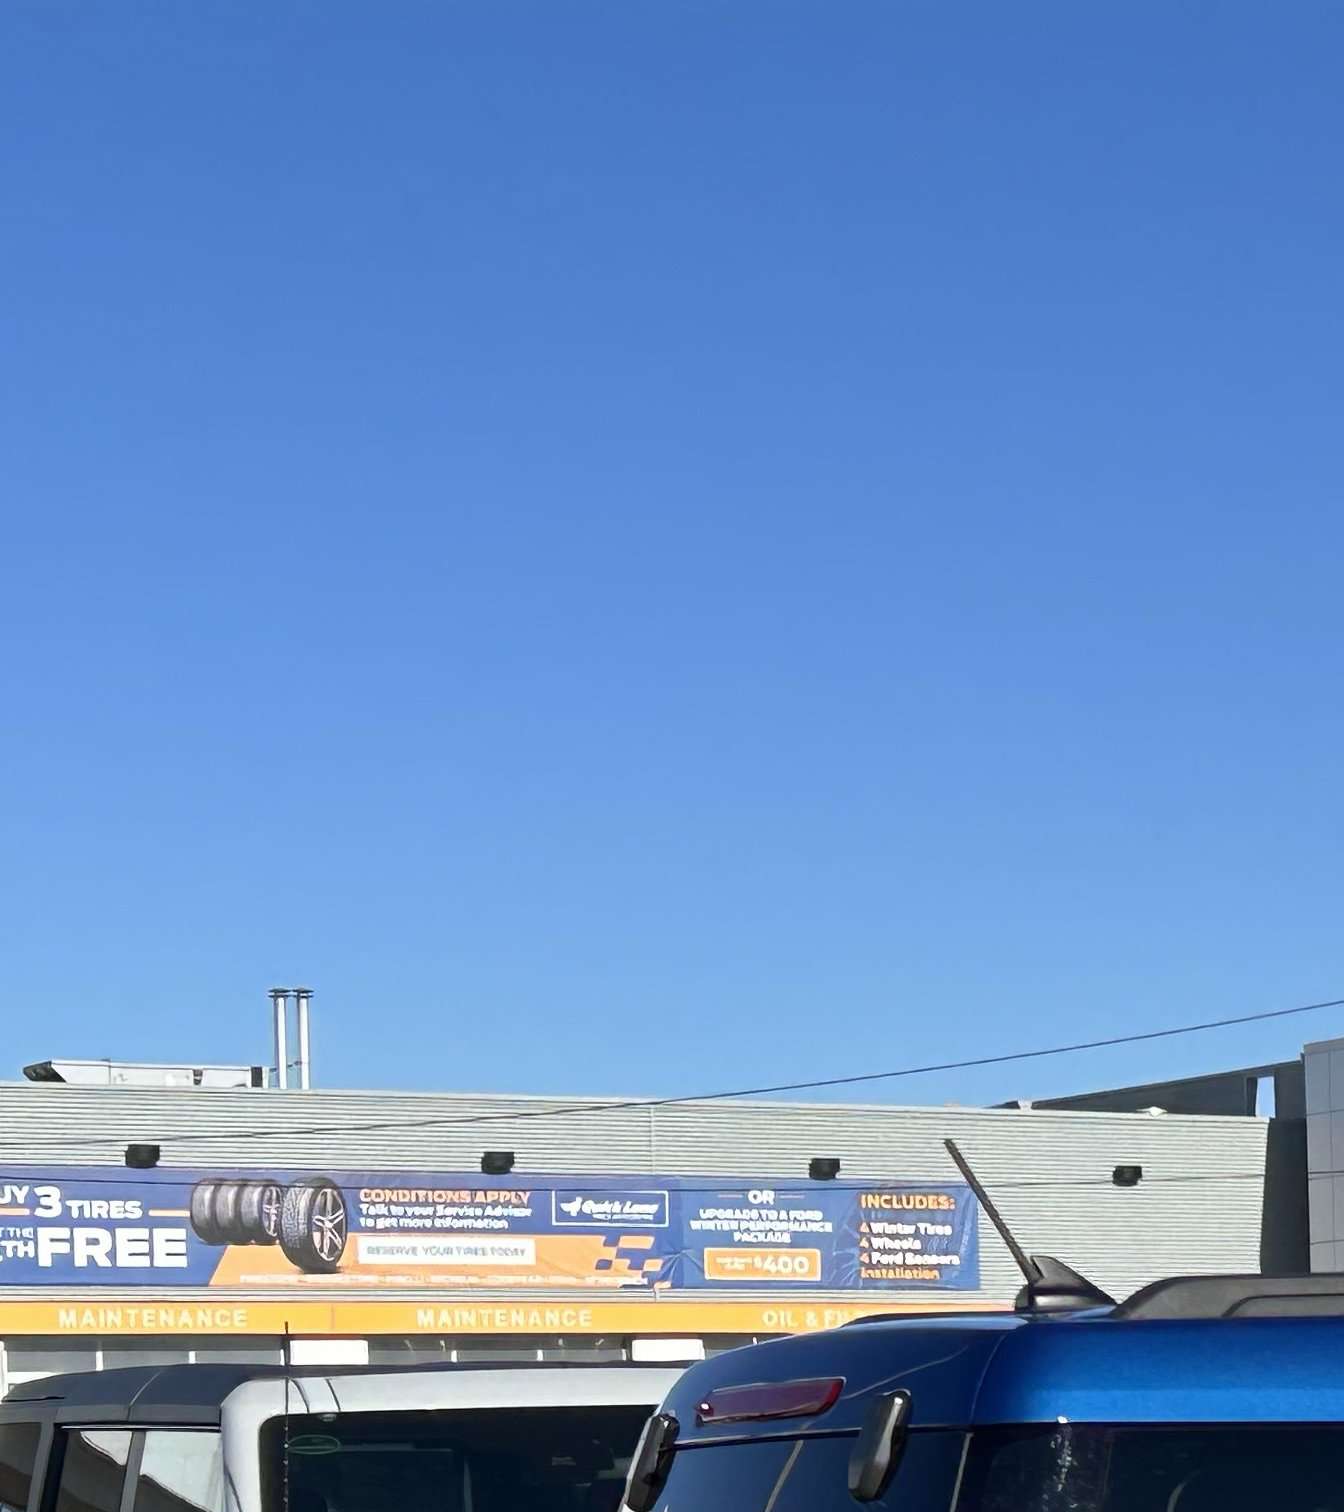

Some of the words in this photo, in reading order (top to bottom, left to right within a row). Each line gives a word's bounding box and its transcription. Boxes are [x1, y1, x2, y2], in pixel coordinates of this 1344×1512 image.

[0, 1185, 30, 1204] UY
[34, 1186, 63, 1218] 3
[66, 1200, 144, 1219] TIRES
[359, 1189, 471, 1203] CONDITIONS
[474, 1190, 532, 1206] APPLY
[747, 1190, 775, 1205] OR
[861, 1194, 956, 1210] INCLUDES:
[0, 1240, 35, 1261] TH
[36, 1227, 188, 1268] FREE
[58, 1308, 249, 1328] MAINTENANCE
[416, 1308, 593, 1328] MAINTENANCE
[762, 1310, 799, 1328] OIL
